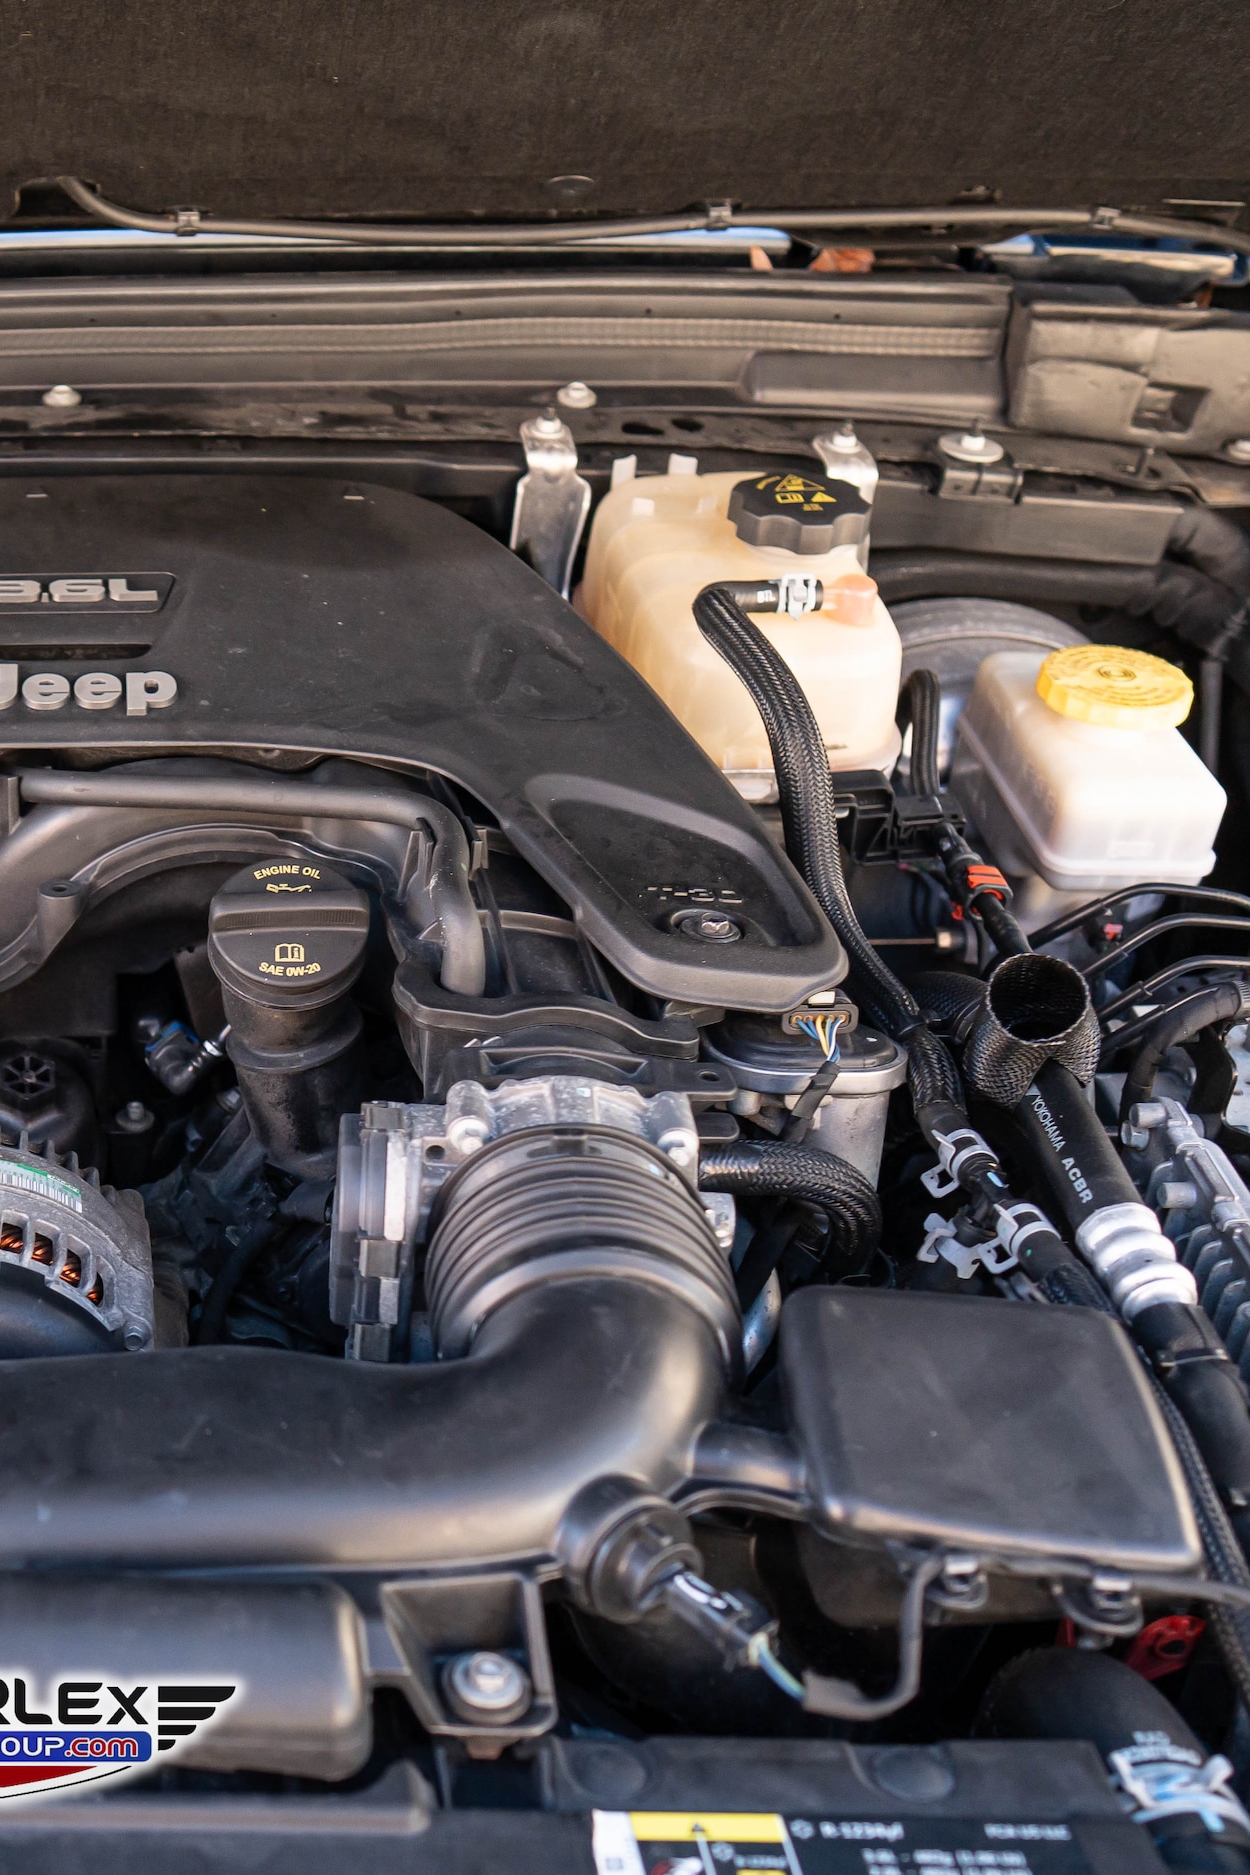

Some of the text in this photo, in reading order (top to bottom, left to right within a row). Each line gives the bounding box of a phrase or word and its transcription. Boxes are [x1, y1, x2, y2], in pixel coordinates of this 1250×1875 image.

[253, 864, 321, 881] ENGINE OIL
[258, 961, 321, 977] SAE 0W-20
[1030, 1094, 1094, 1205] YOKOHAMA ACBR
